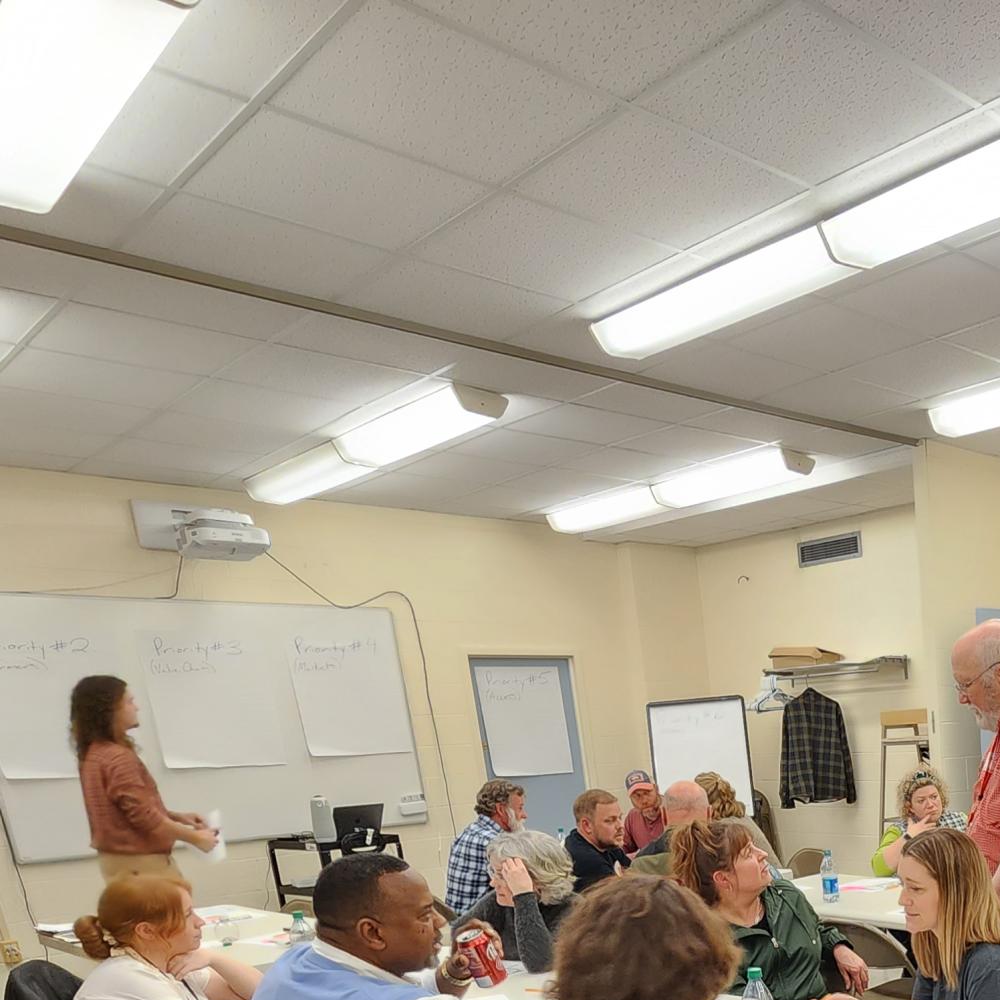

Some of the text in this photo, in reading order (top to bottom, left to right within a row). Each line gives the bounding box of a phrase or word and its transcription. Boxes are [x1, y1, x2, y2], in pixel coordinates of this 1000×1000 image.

[0, 638, 46, 660] iority
[153, 636, 209, 662] Priority
[294, 636, 345, 660] Priority
